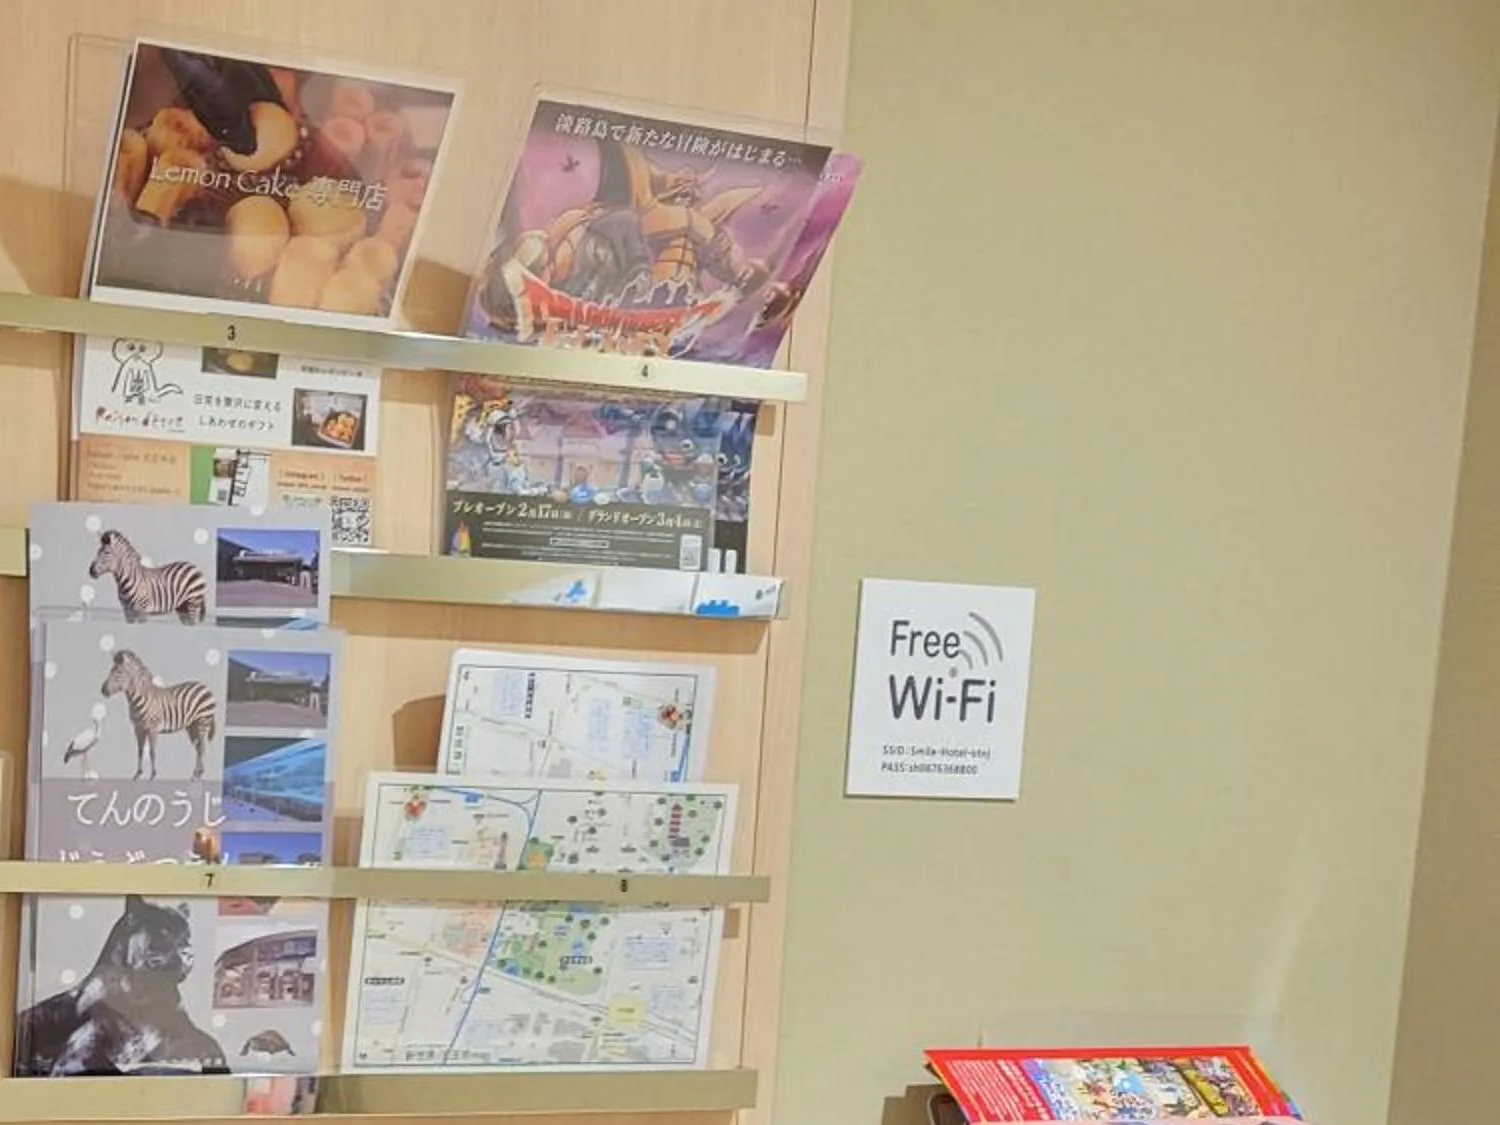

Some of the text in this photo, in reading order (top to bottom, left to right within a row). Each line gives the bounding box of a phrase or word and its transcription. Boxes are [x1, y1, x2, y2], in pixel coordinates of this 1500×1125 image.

[149, 156, 231, 190] Lemon
[238, 169, 299, 199] Cake
[227, 325, 236, 341] 3
[890, 619, 960, 659] Free
[888, 674, 996, 723] Wi-Fi
[67, 791, 227, 828] てんのうじ
[204, 872, 215, 887] 7
